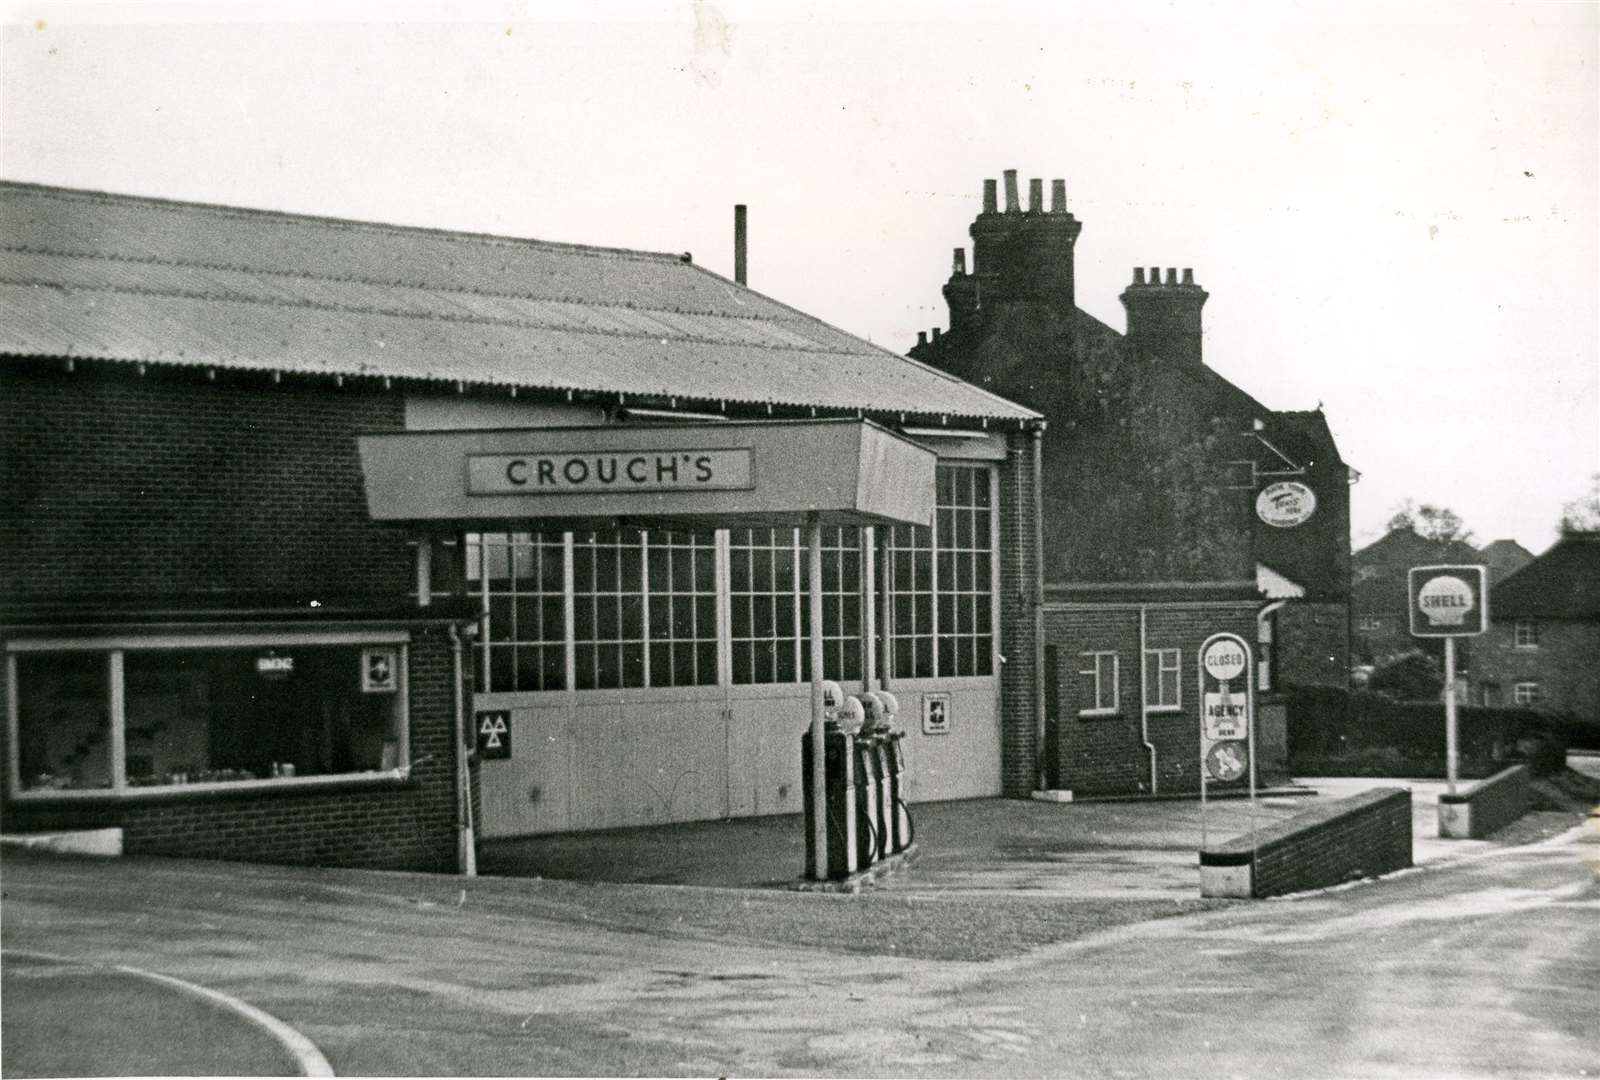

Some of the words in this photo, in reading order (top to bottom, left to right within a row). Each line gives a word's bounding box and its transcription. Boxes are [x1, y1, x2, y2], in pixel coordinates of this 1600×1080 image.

[506, 456, 713, 485] CROUCH'S
[1423, 594, 1468, 608] SHELL
[1207, 654, 1242, 666] CLOSED
[1208, 704, 1244, 717] AGENCY
